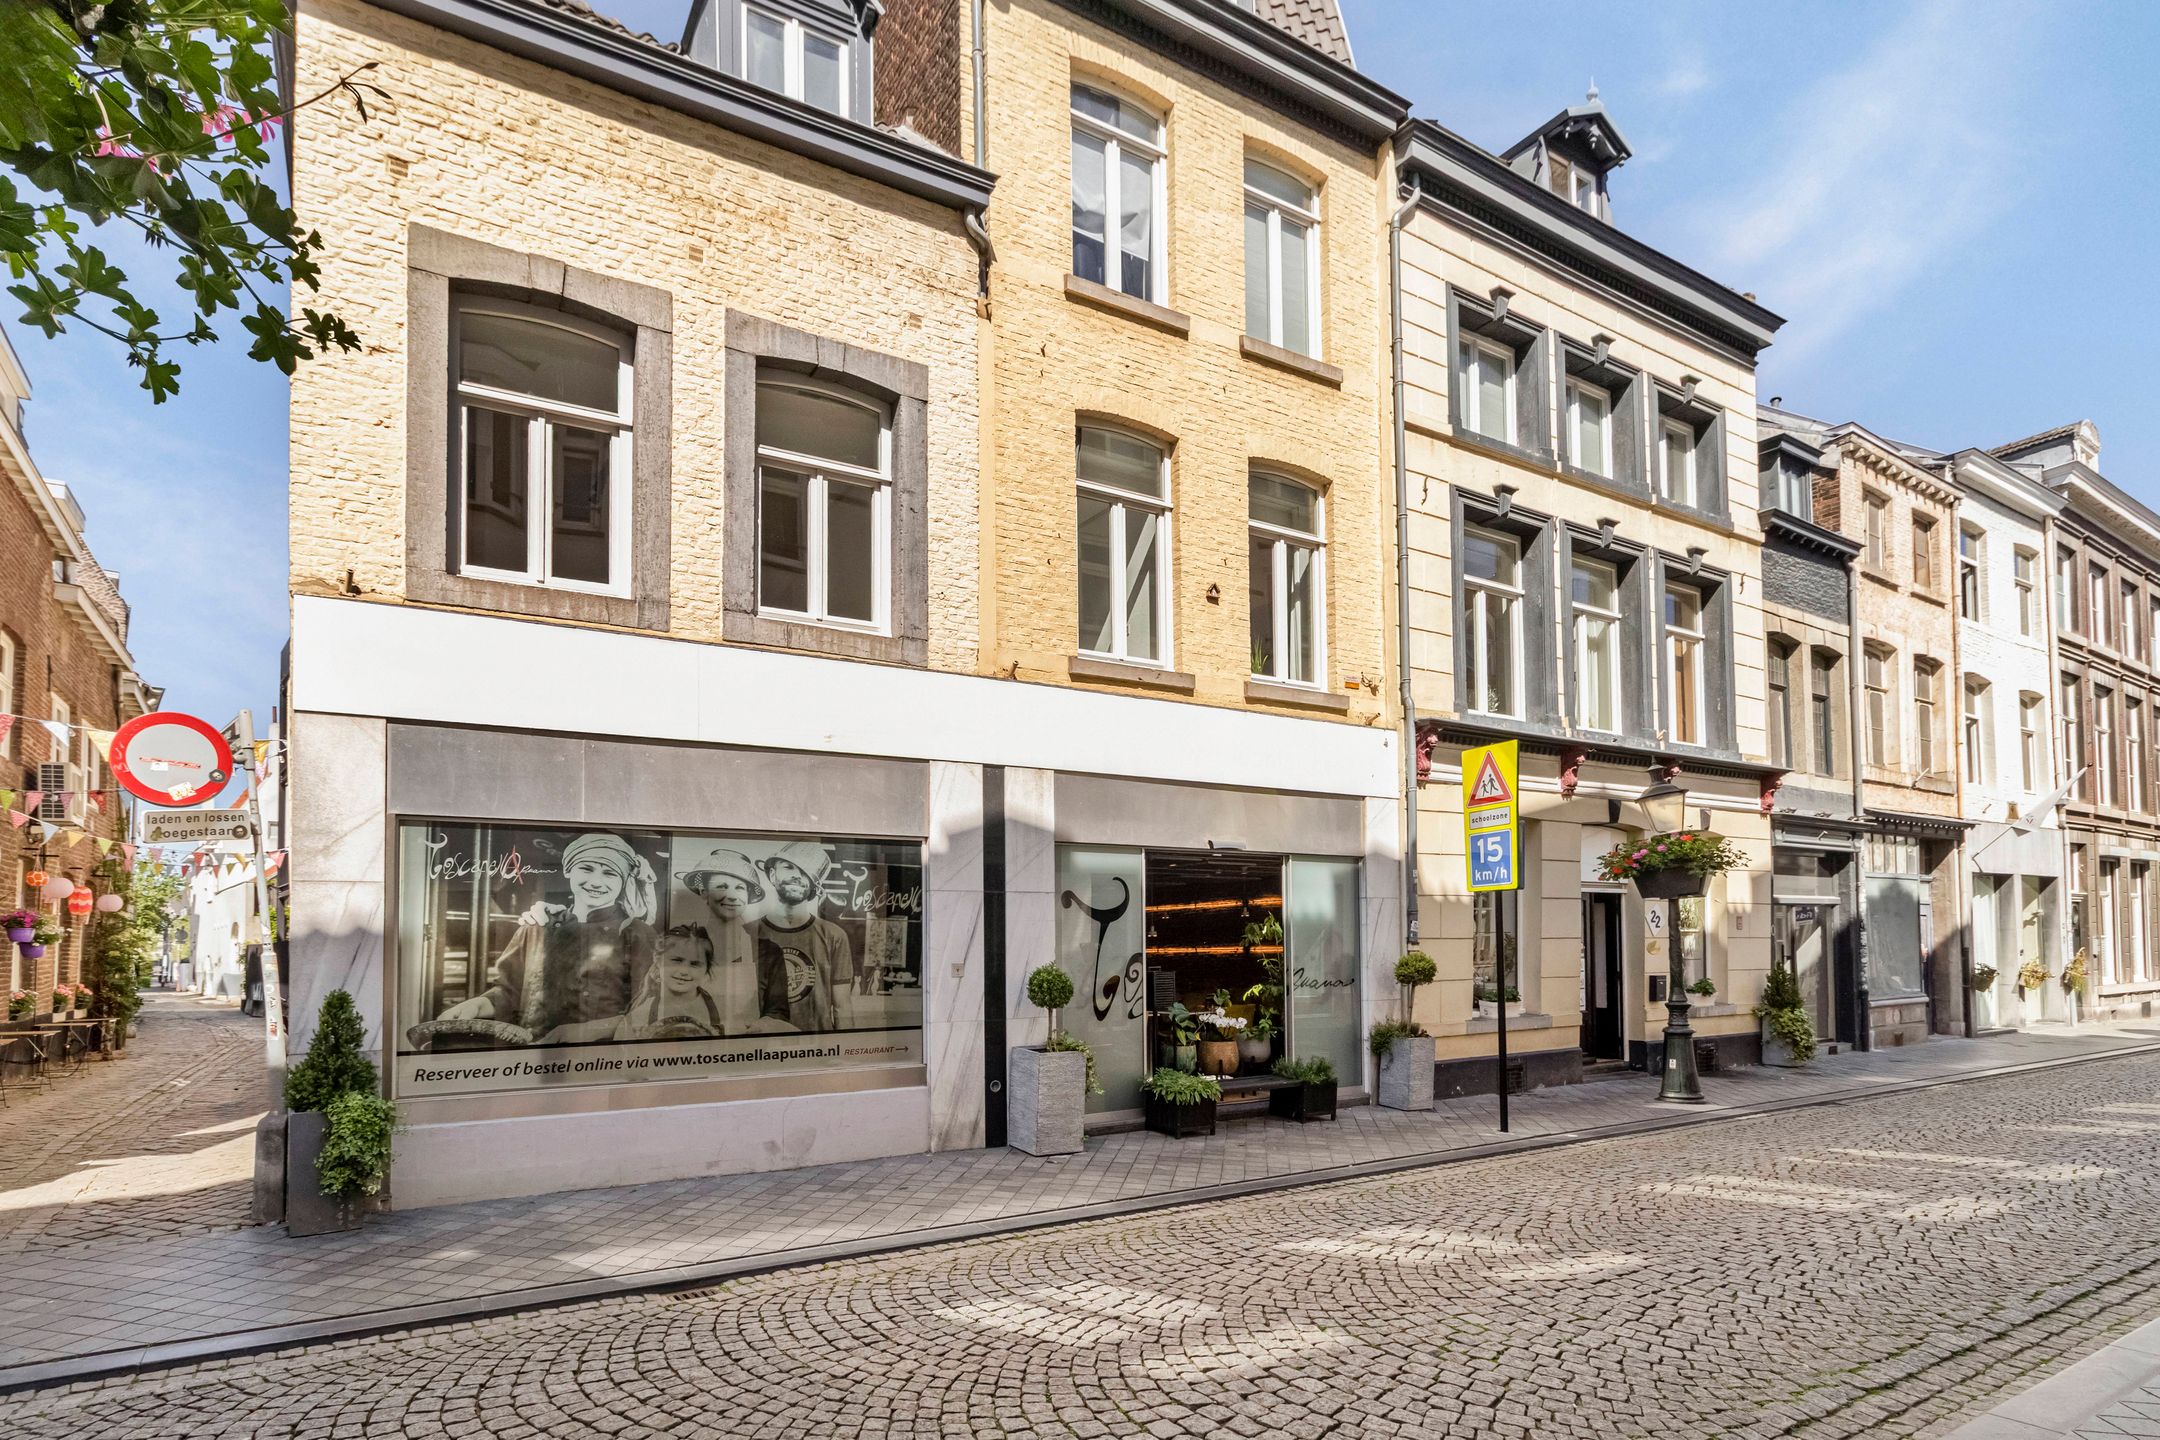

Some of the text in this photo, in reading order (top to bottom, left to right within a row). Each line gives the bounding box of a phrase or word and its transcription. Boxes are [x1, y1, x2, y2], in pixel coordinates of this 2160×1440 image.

[147, 813, 245, 825] laden en lossen
[1471, 812, 1508, 824] schoolzone
[1477, 836, 1503, 864] 15
[1475, 866, 1508, 882] km/h
[1650, 910, 1661, 928] 22
[844, 1046, 895, 1056] RESTAURANT
[414, 1045, 840, 1082] Reserveer of bestel online via www.toscanellaapuana.nl
